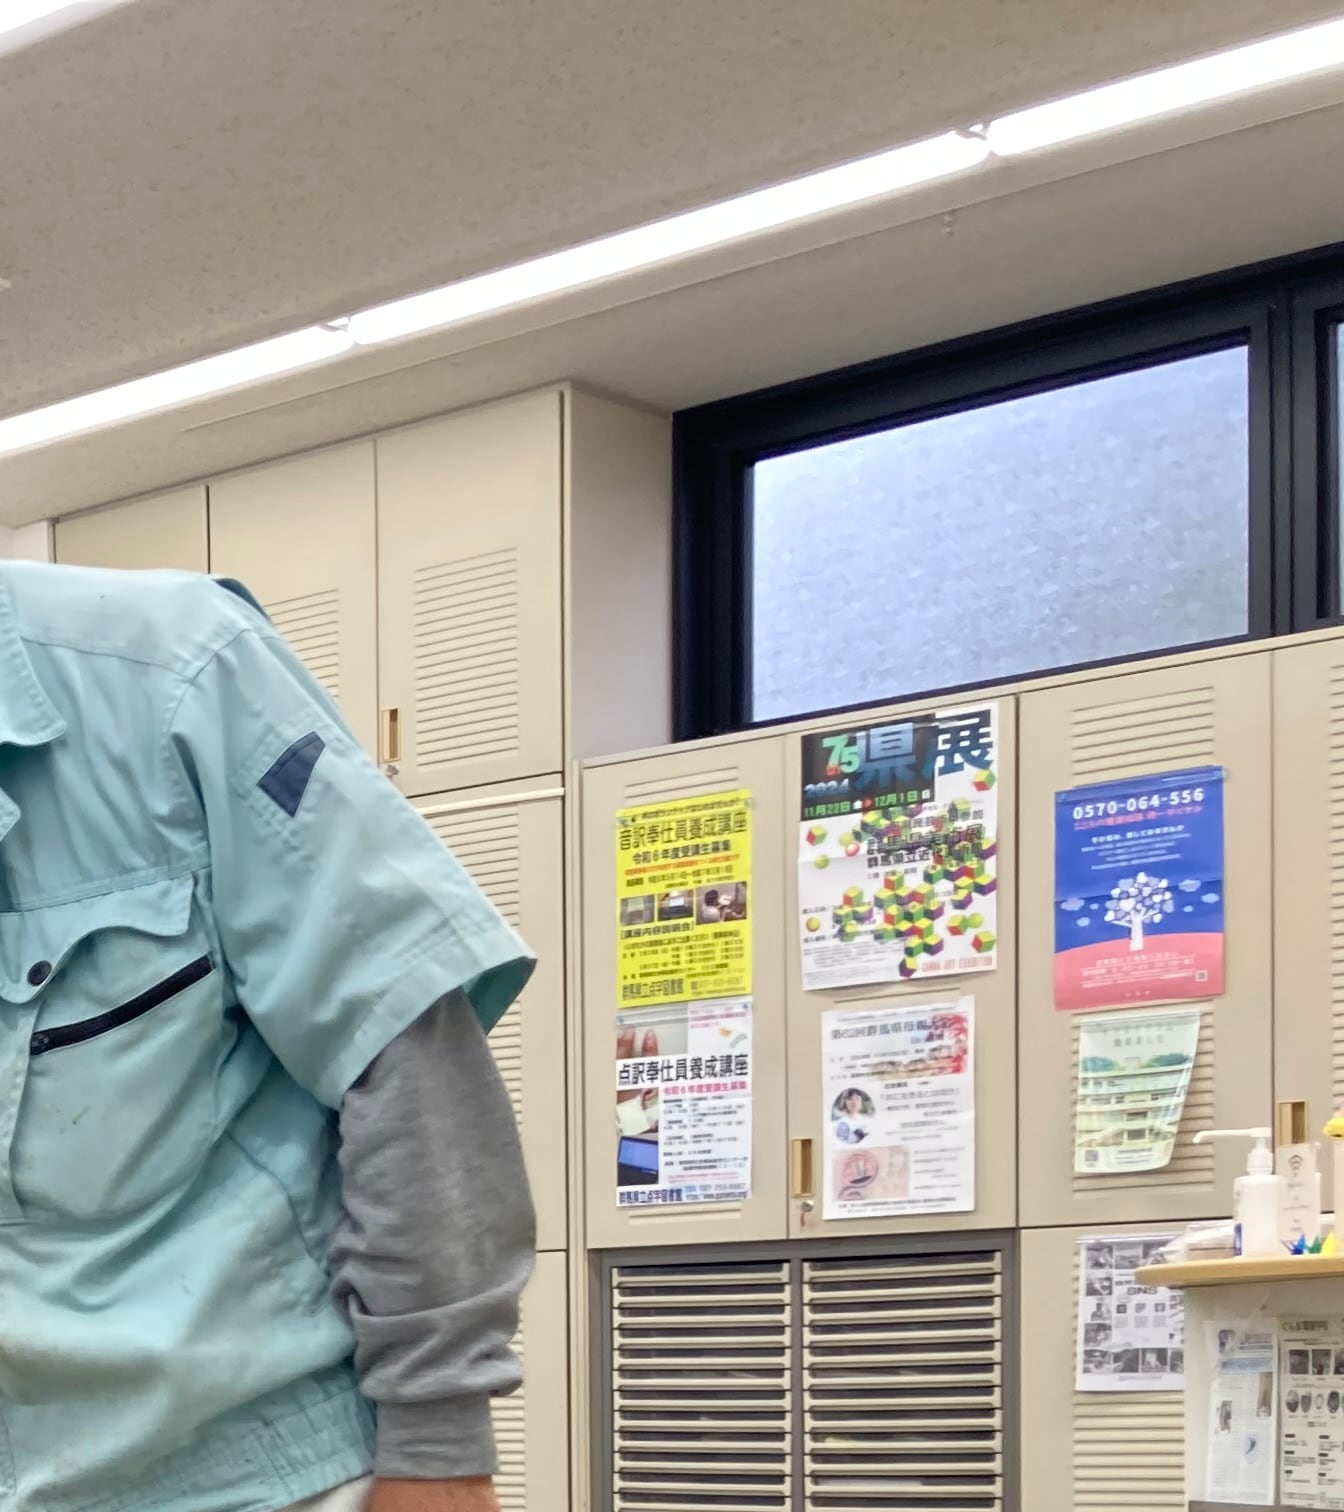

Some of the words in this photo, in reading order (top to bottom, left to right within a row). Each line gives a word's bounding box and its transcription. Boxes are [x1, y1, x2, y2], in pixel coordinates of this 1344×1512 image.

[822, 735, 860, 773] 75
[803, 779, 849, 796] 2024
[1073, 788, 1205, 820] 0570-064-556
[619, 811, 747, 851] 音訳奉仕員養成講座
[618, 1052, 749, 1086] 点訳奉仕員養成講座
